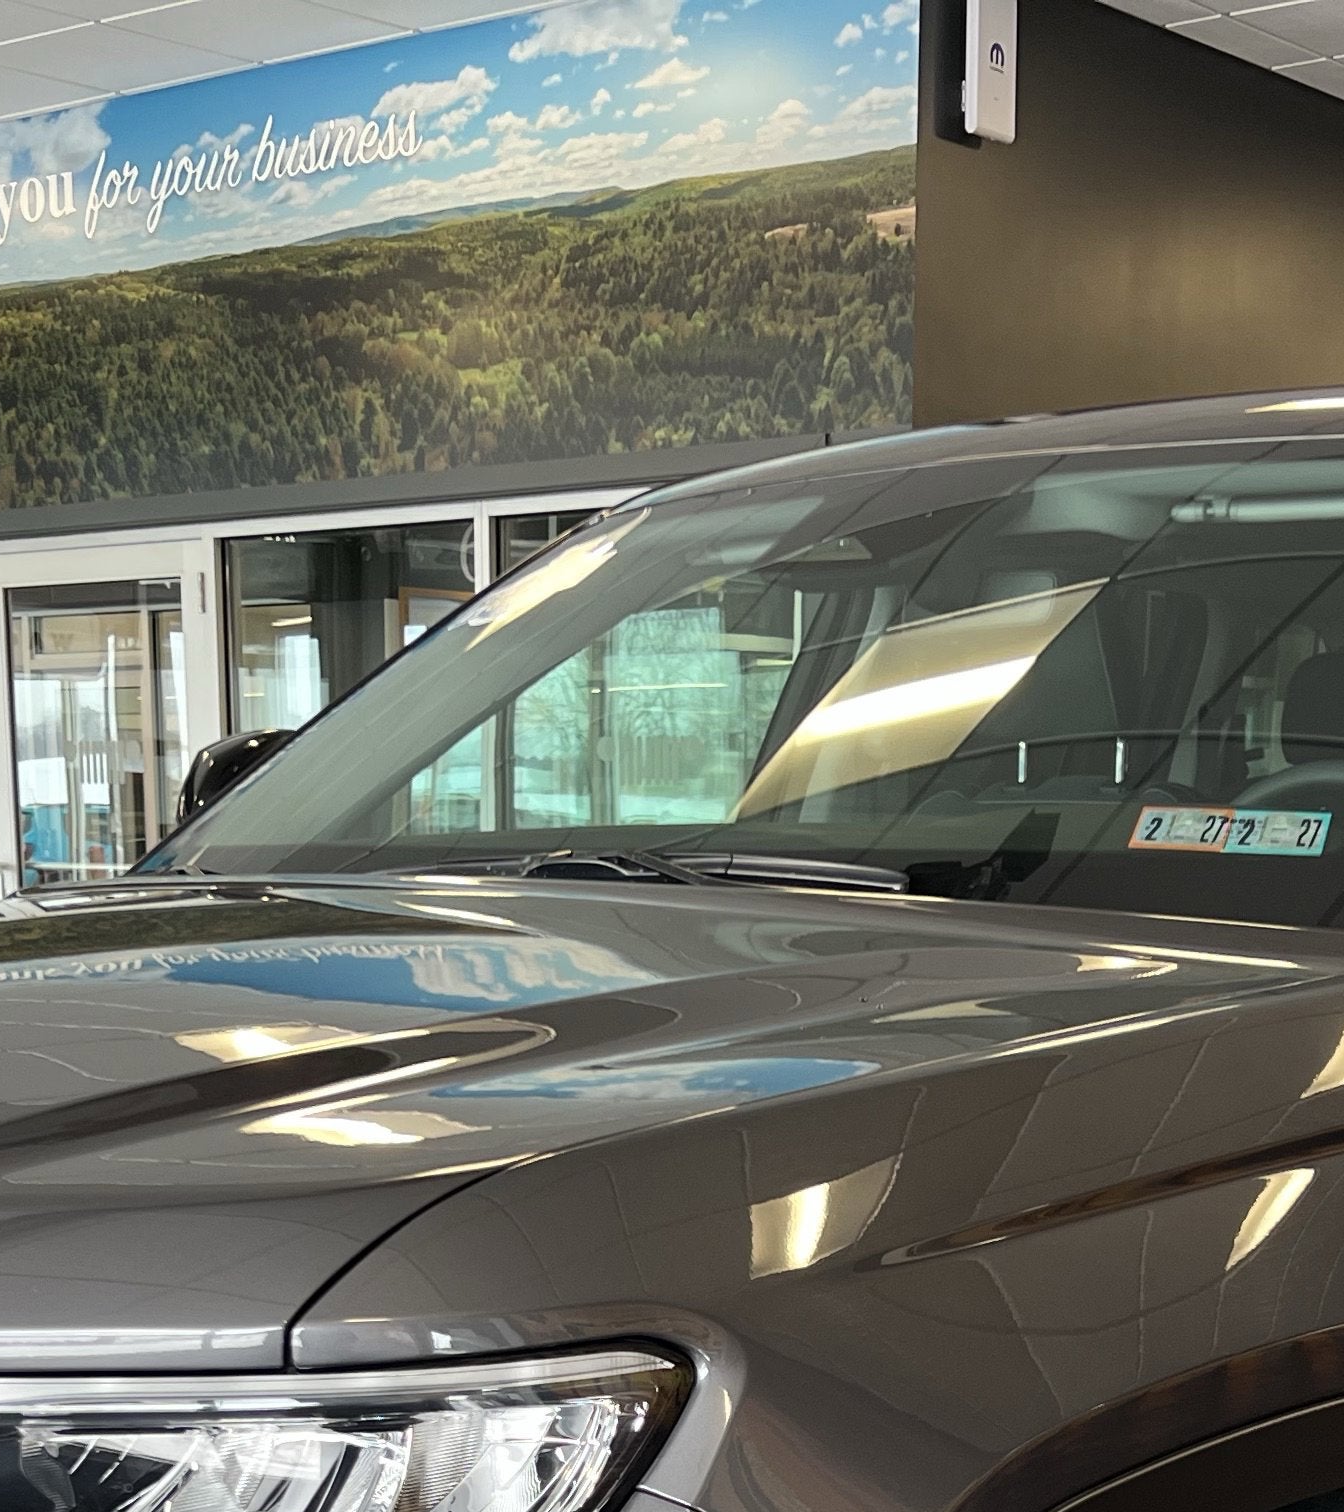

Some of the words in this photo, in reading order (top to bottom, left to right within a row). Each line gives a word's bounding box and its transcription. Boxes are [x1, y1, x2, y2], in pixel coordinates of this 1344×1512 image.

[83, 150, 142, 240] for
[148, 147, 243, 233] your
[251, 108, 423, 181] business
[1144, 817, 1163, 841] 2
[1199, 815, 1230, 846] 27
[1237, 818, 1256, 846] 2
[1296, 818, 1323, 849] 27
